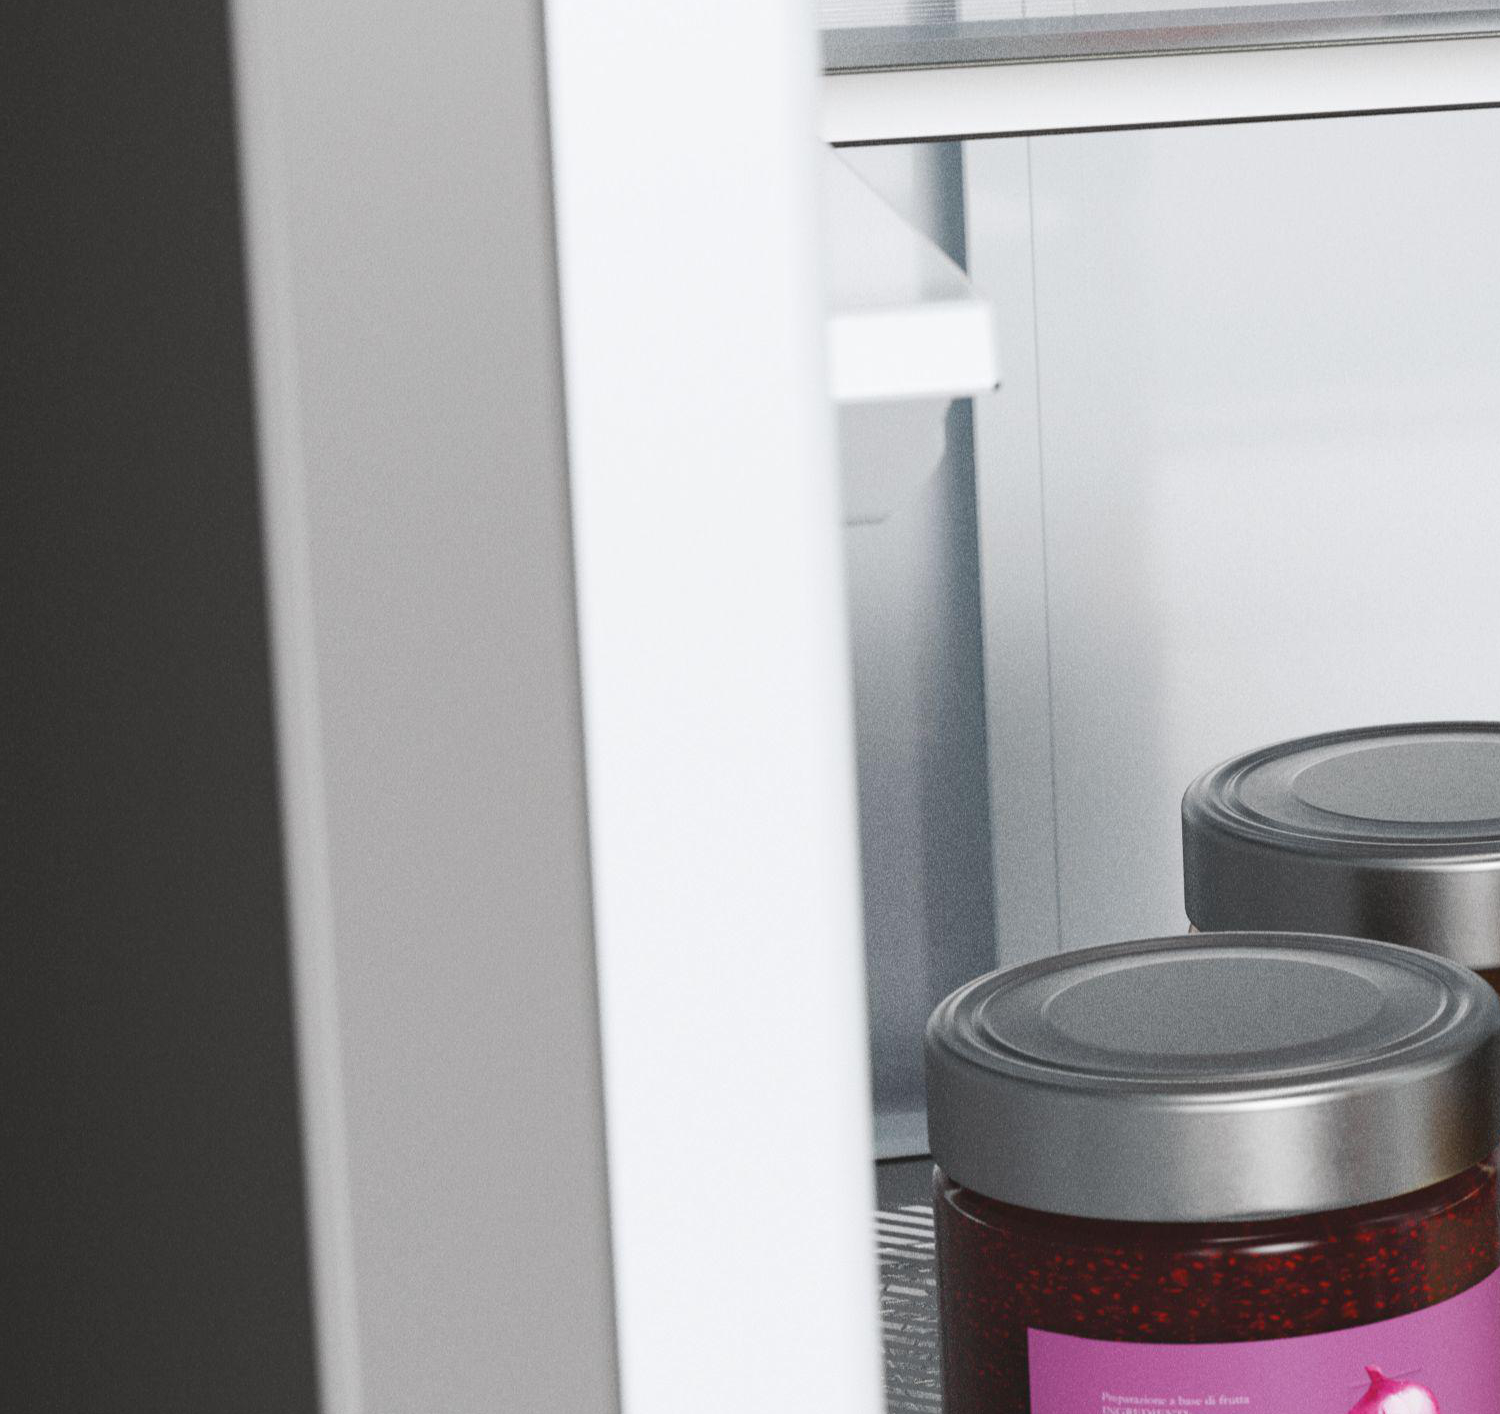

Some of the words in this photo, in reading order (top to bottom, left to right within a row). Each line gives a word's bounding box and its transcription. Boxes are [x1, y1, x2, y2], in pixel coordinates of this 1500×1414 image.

[1178, 1395, 1201, 1406] base
[1205, 1395, 1216, 1406] di
[1219, 1394, 1249, 1405] frutta
